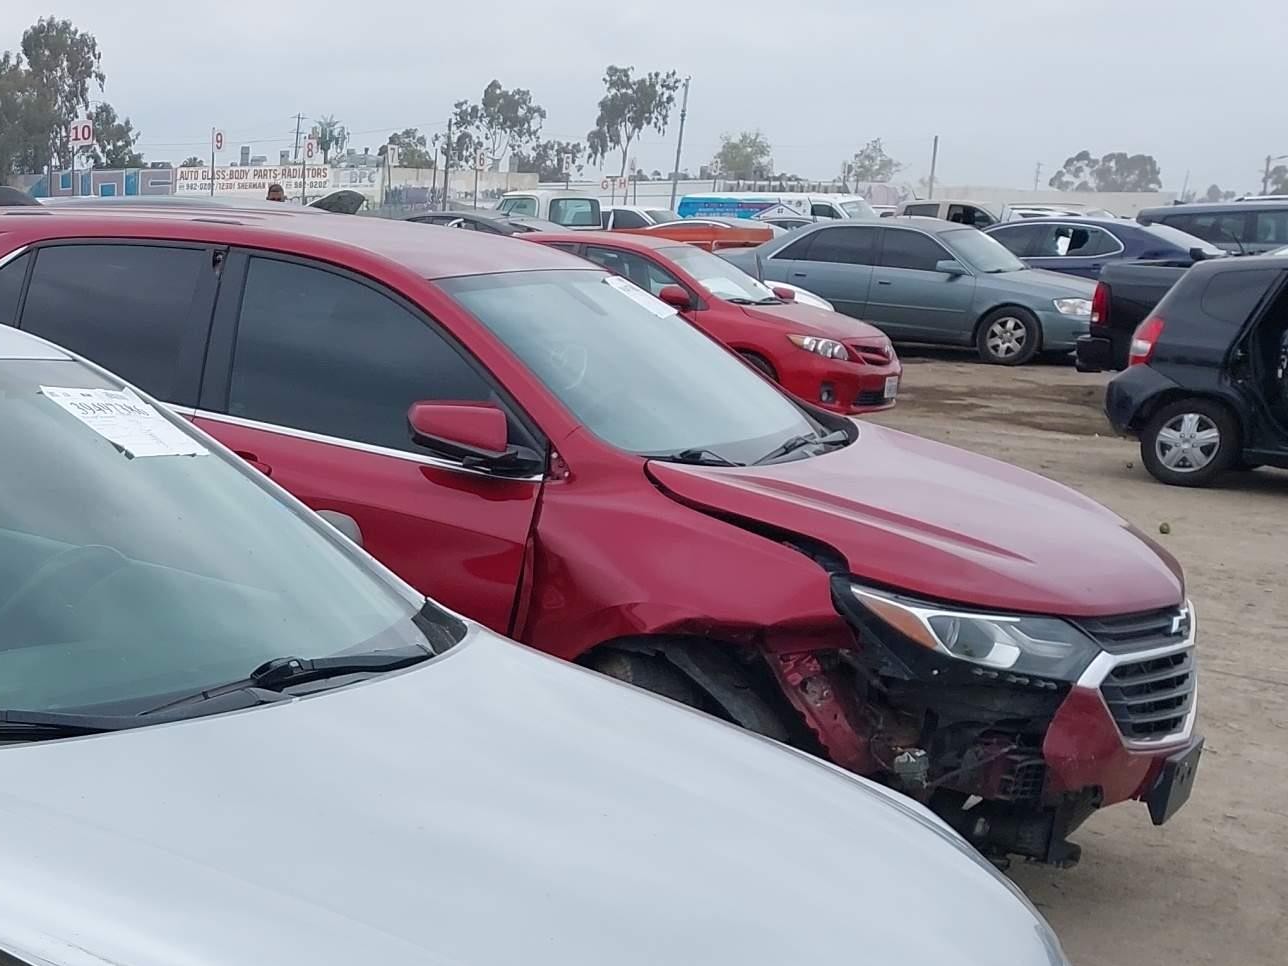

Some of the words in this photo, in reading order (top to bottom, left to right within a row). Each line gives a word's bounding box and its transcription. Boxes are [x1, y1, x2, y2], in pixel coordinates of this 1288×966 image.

[71, 125, 91, 142] 10
[215, 132, 223, 150] 9
[306, 142, 314, 158] 8
[478, 153, 484, 166] 6
[179, 168, 199, 180] AUTO
